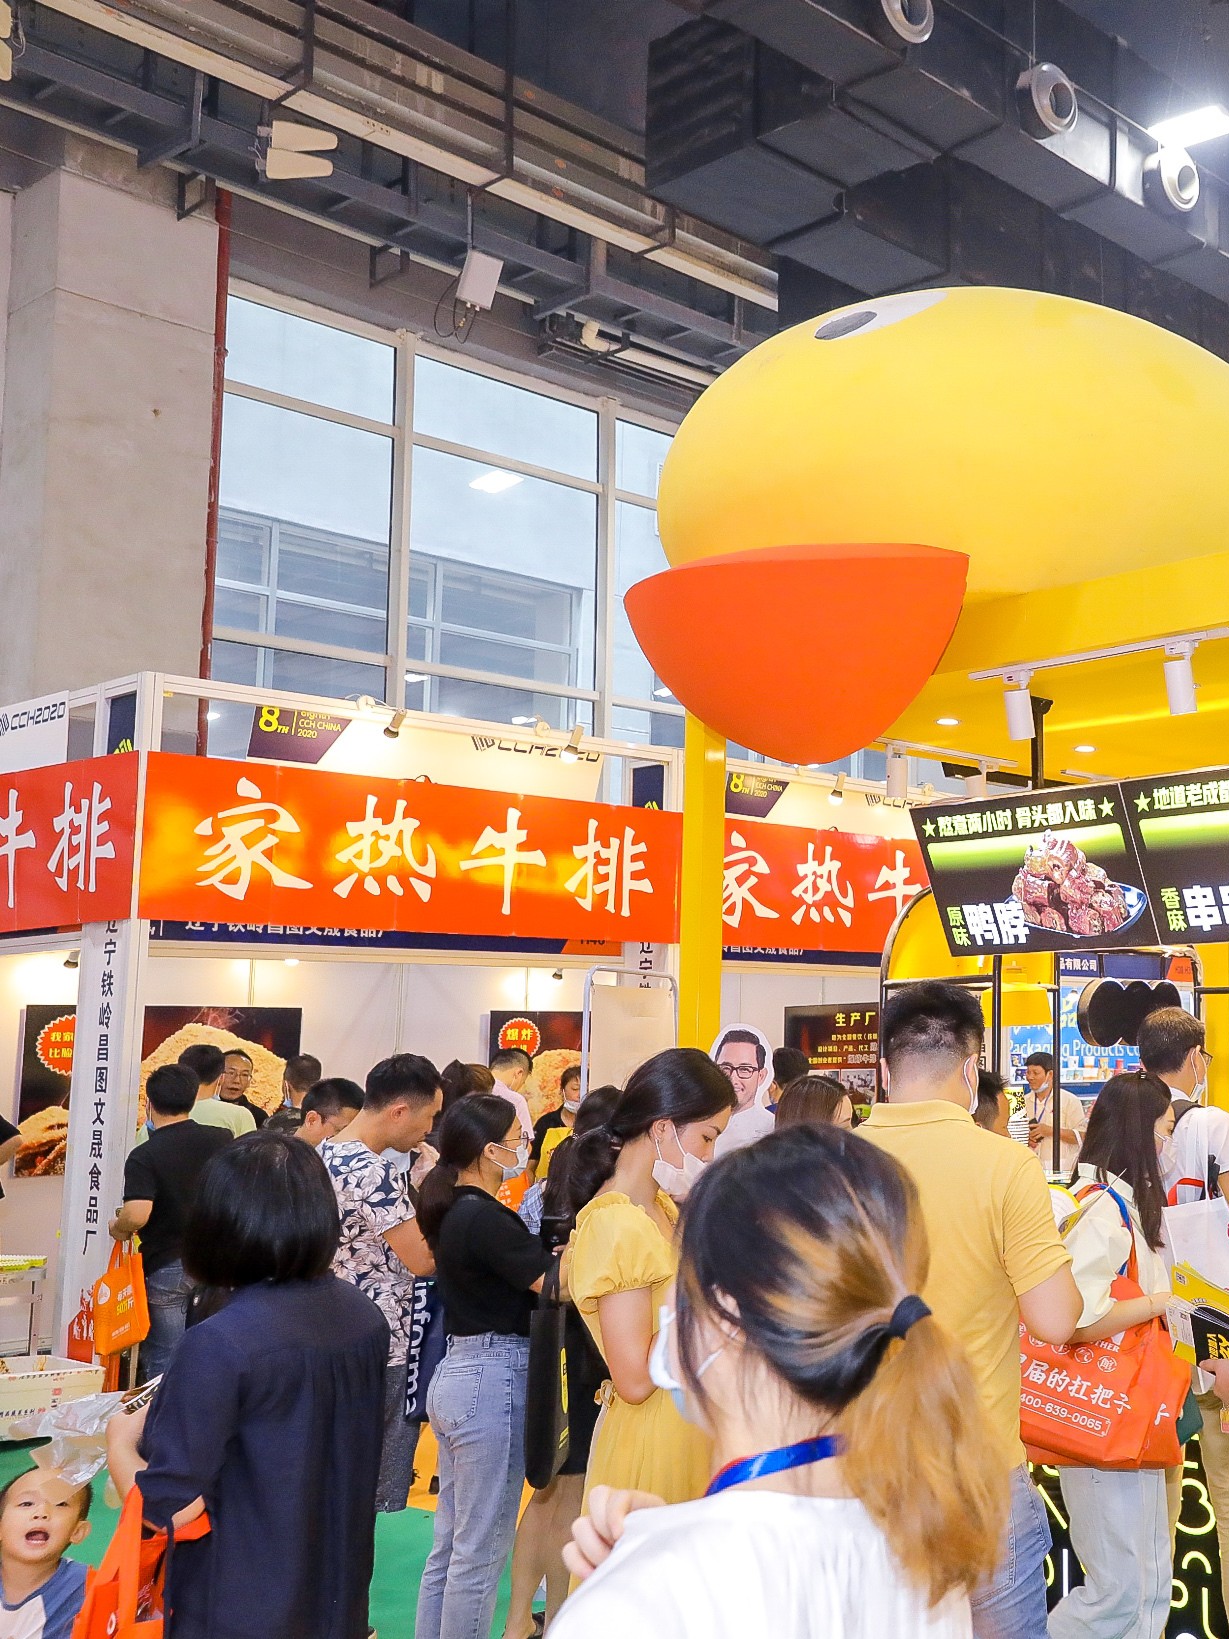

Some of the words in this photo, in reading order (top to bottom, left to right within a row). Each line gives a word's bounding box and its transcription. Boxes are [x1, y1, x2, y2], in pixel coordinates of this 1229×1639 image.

[297, 728, 318, 739] 2020
[298, 719, 316, 729] CCH
[317, 721, 342, 732] CHINA
[1015, 798, 1097, 830] 骨头都入味
[193, 777, 655, 918] 家热牛排
[946, 906, 972, 947] 原味
[962, 901, 1031, 946] 鸭脖
[1160, 886, 1188, 932] 香麻
